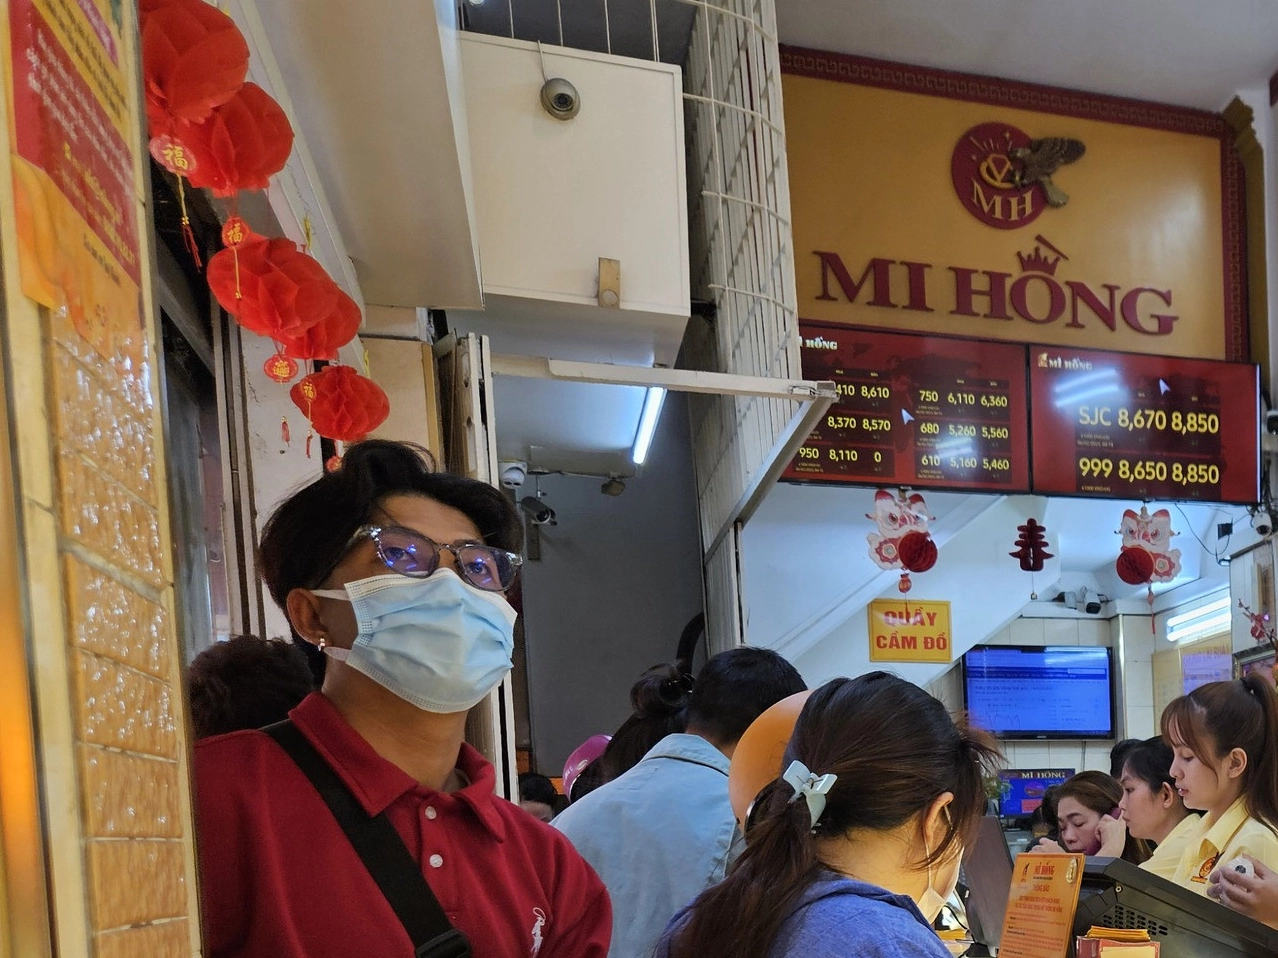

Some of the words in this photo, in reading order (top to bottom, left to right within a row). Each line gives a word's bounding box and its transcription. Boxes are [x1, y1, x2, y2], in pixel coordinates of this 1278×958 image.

[163, 144, 188, 170] 福
[971, 178, 1034, 221] MH
[227, 222, 243, 243] 福
[812, 251, 934, 312] MI
[948, 235, 1179, 336] HỒNG
[835, 384, 855, 396] 410
[861, 385, 890, 399] 8,610
[919, 390, 939, 402] 750
[947, 392, 975, 405] 6,110
[980, 395, 1008, 407] 6,360
[827, 416, 857, 430] 8,370
[862, 418, 891, 432] 8,570
[920, 422, 940, 435] 680
[948, 424, 976, 437] 5,260
[981, 426, 1009, 439] 5,560
[1079, 406, 1112, 426] SJC
[1118, 407, 1167, 432] 8,670
[1171, 411, 1219, 435] 8,850
[799, 447, 819, 459] 950
[829, 449, 858, 462] 8,110
[874, 451, 882, 462] 0
[921, 454, 941, 466] 610
[950, 457, 977, 469] 5,160
[982, 458, 1010, 471] 5,460
[1079, 457, 1113, 478] 999
[1118, 459, 1167, 483] 8,650
[1172, 462, 1220, 486] 8,850
[884, 606, 937, 627] QUẦY
[876, 631, 917, 650] CẦM
[923, 632, 947, 650] ĐỒ
